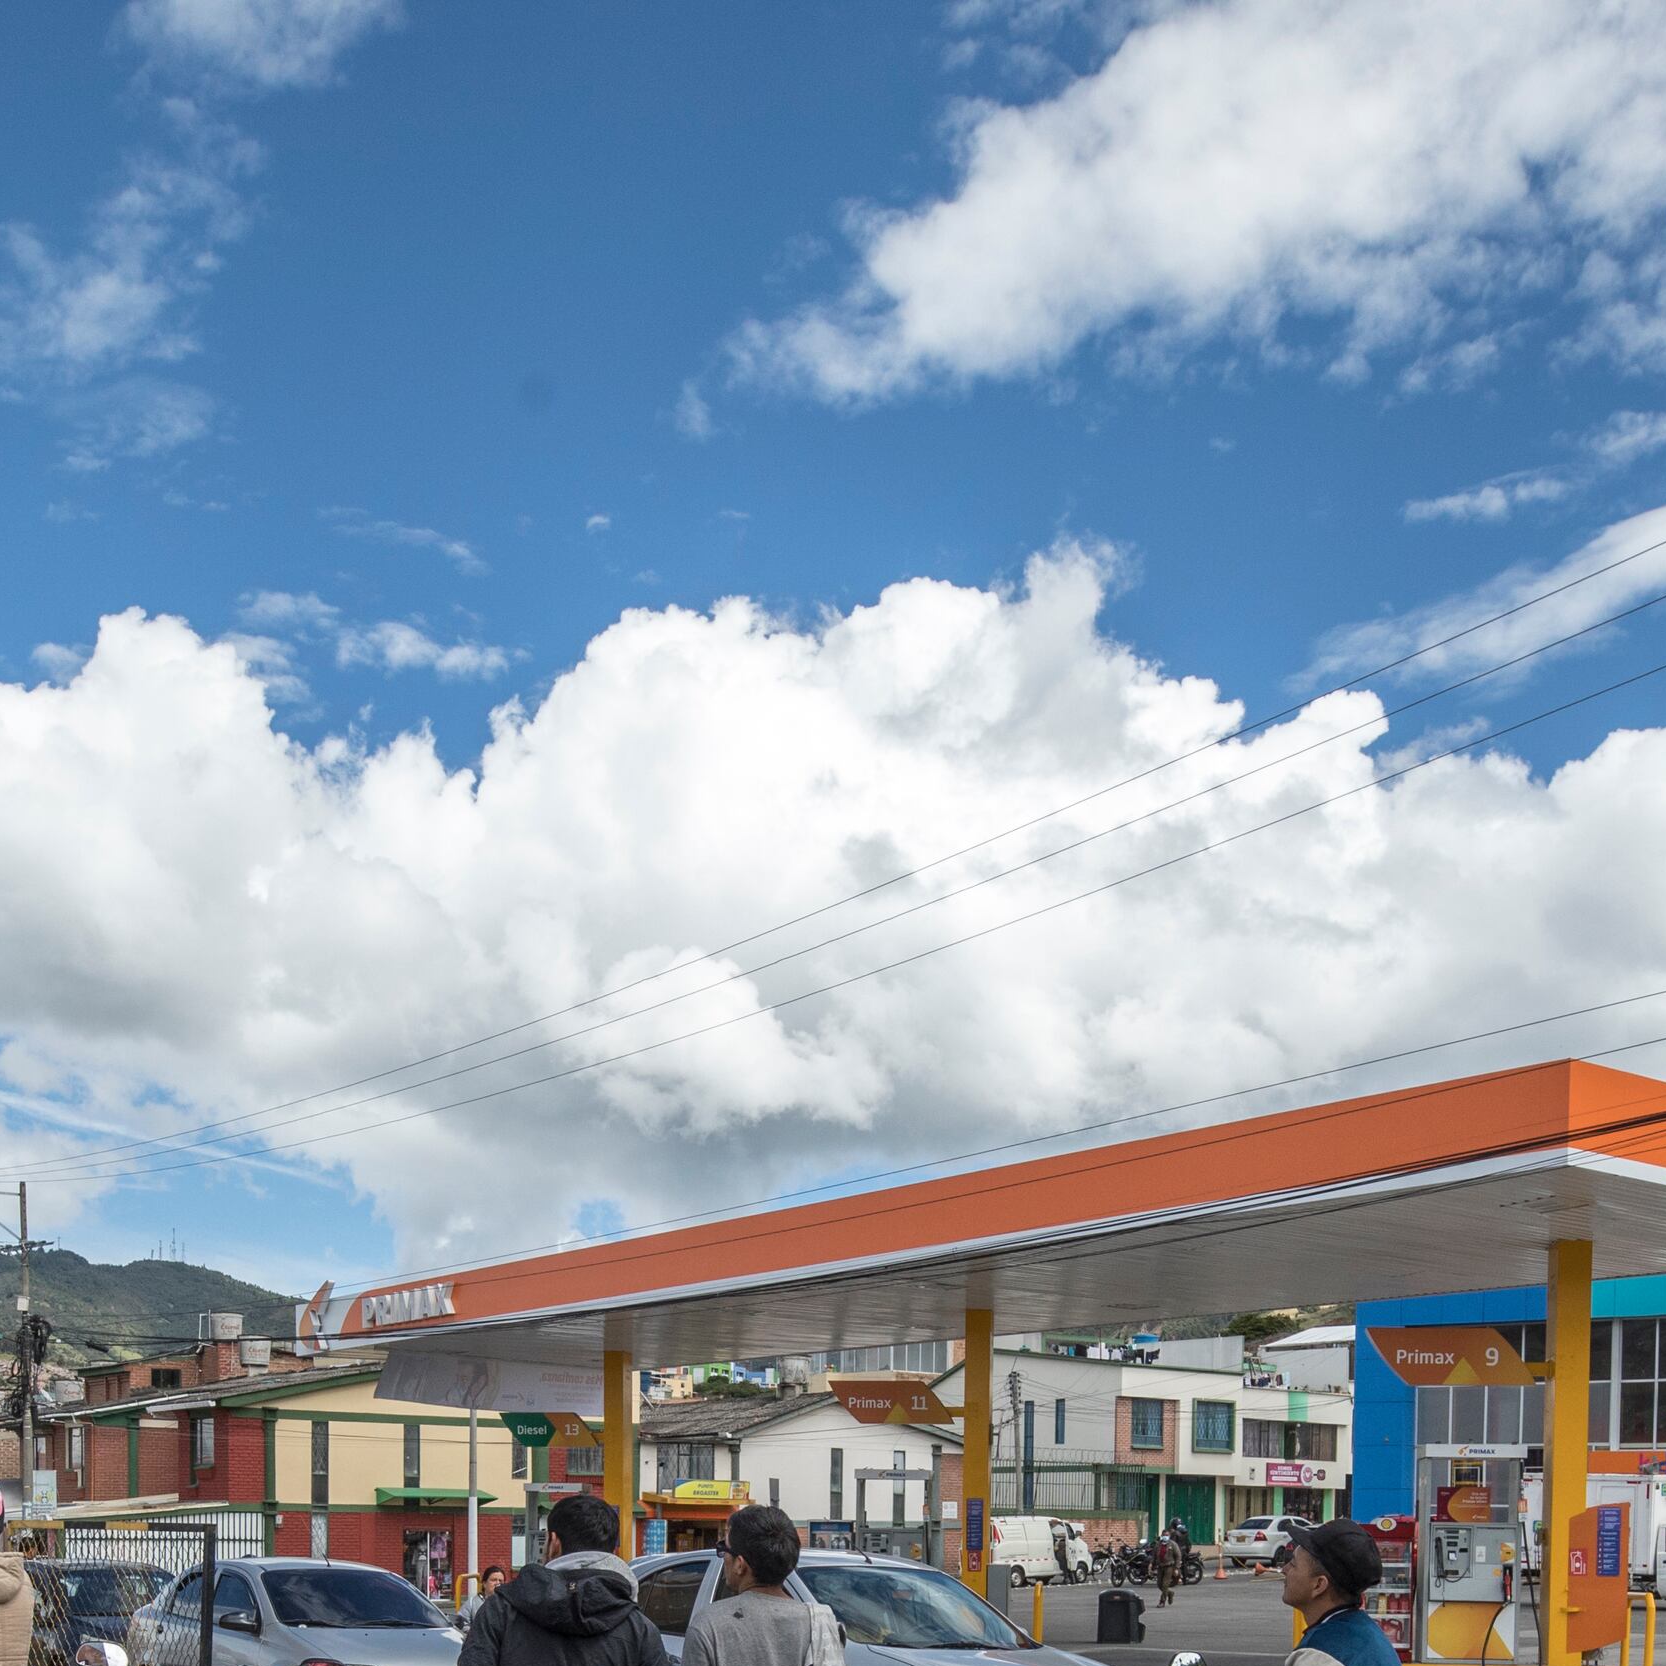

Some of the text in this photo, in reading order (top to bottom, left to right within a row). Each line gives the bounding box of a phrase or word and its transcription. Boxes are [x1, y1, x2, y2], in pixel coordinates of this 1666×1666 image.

[361, 1281, 456, 1329] PRIMAX
[1396, 1347, 1500, 1366] Primax 9
[848, 1395, 929, 1410] Primax 11
[517, 1423, 580, 1436] Diesel 13
